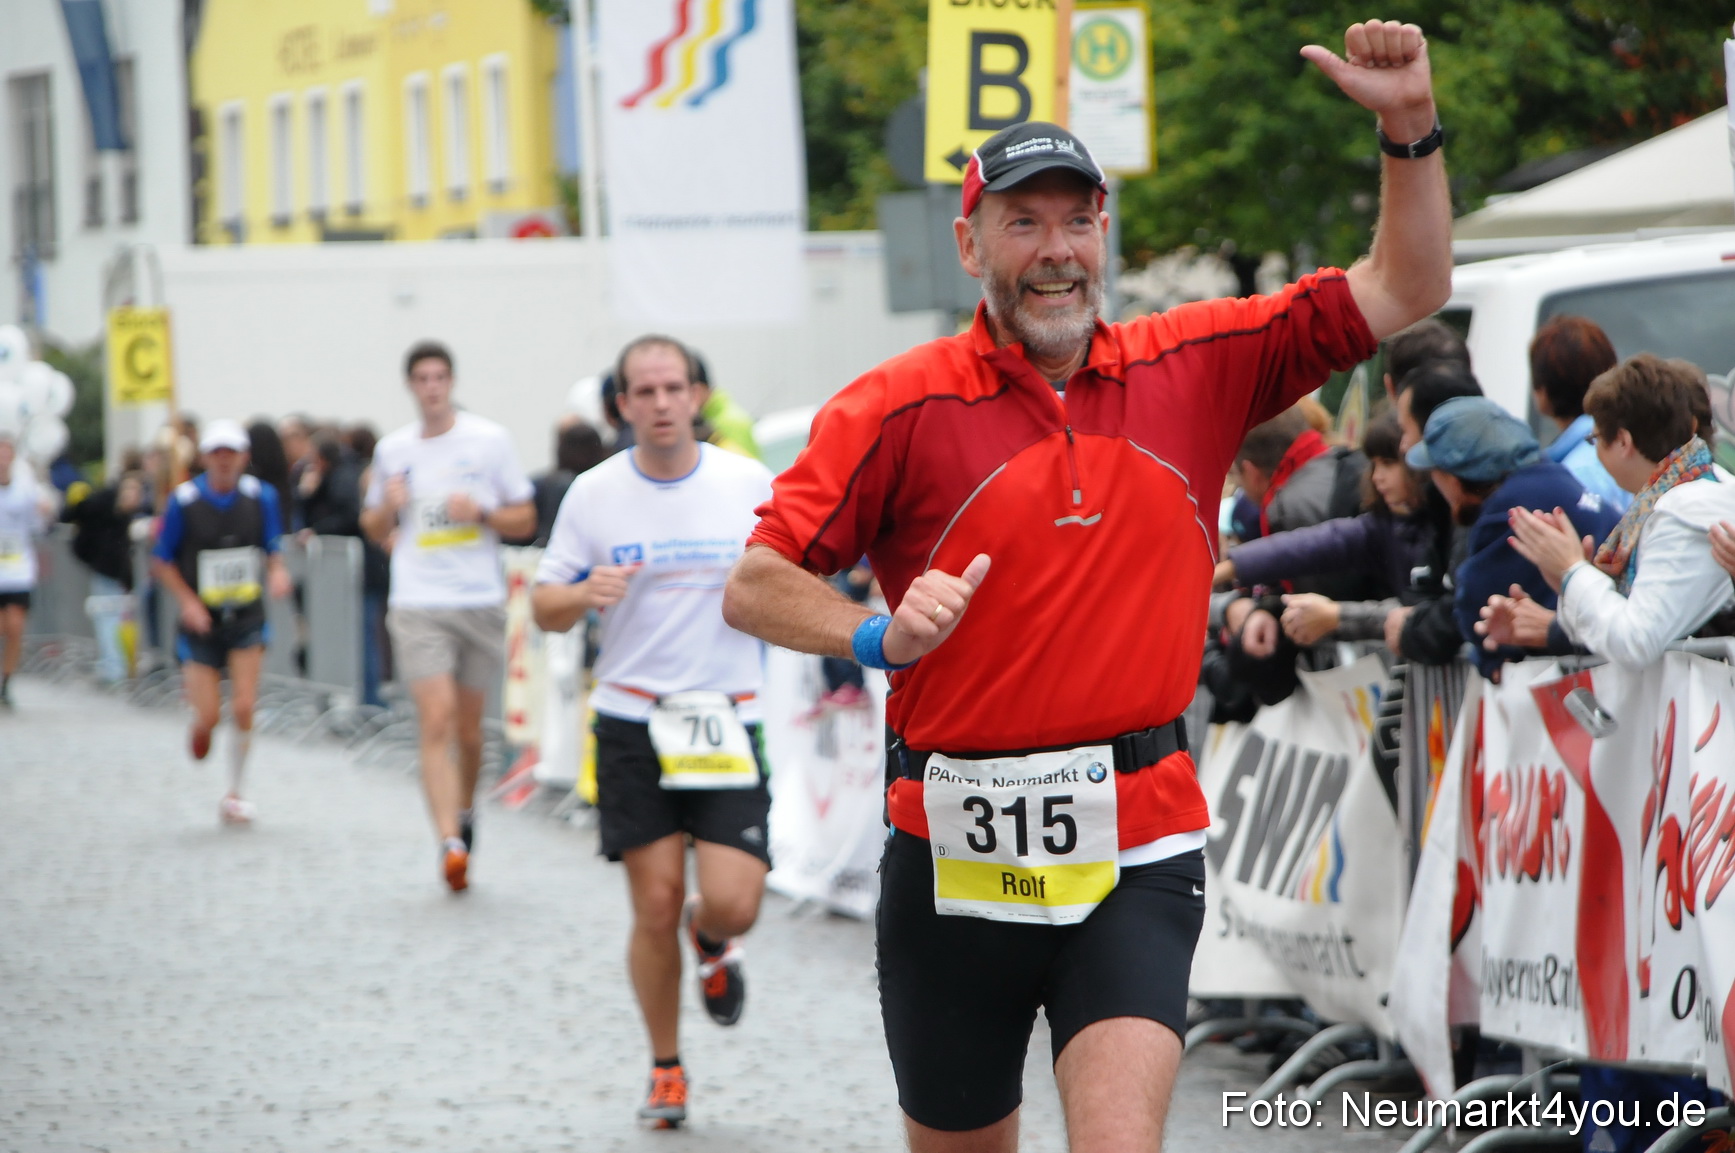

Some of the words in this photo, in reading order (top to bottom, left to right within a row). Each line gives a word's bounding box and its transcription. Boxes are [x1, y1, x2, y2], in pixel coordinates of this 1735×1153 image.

[967, 30, 1032, 131] B
[125, 334, 160, 384] C
[682, 714, 723, 747] 70
[962, 795, 1078, 857] 315
[1001, 872, 1046, 899] Rolf
